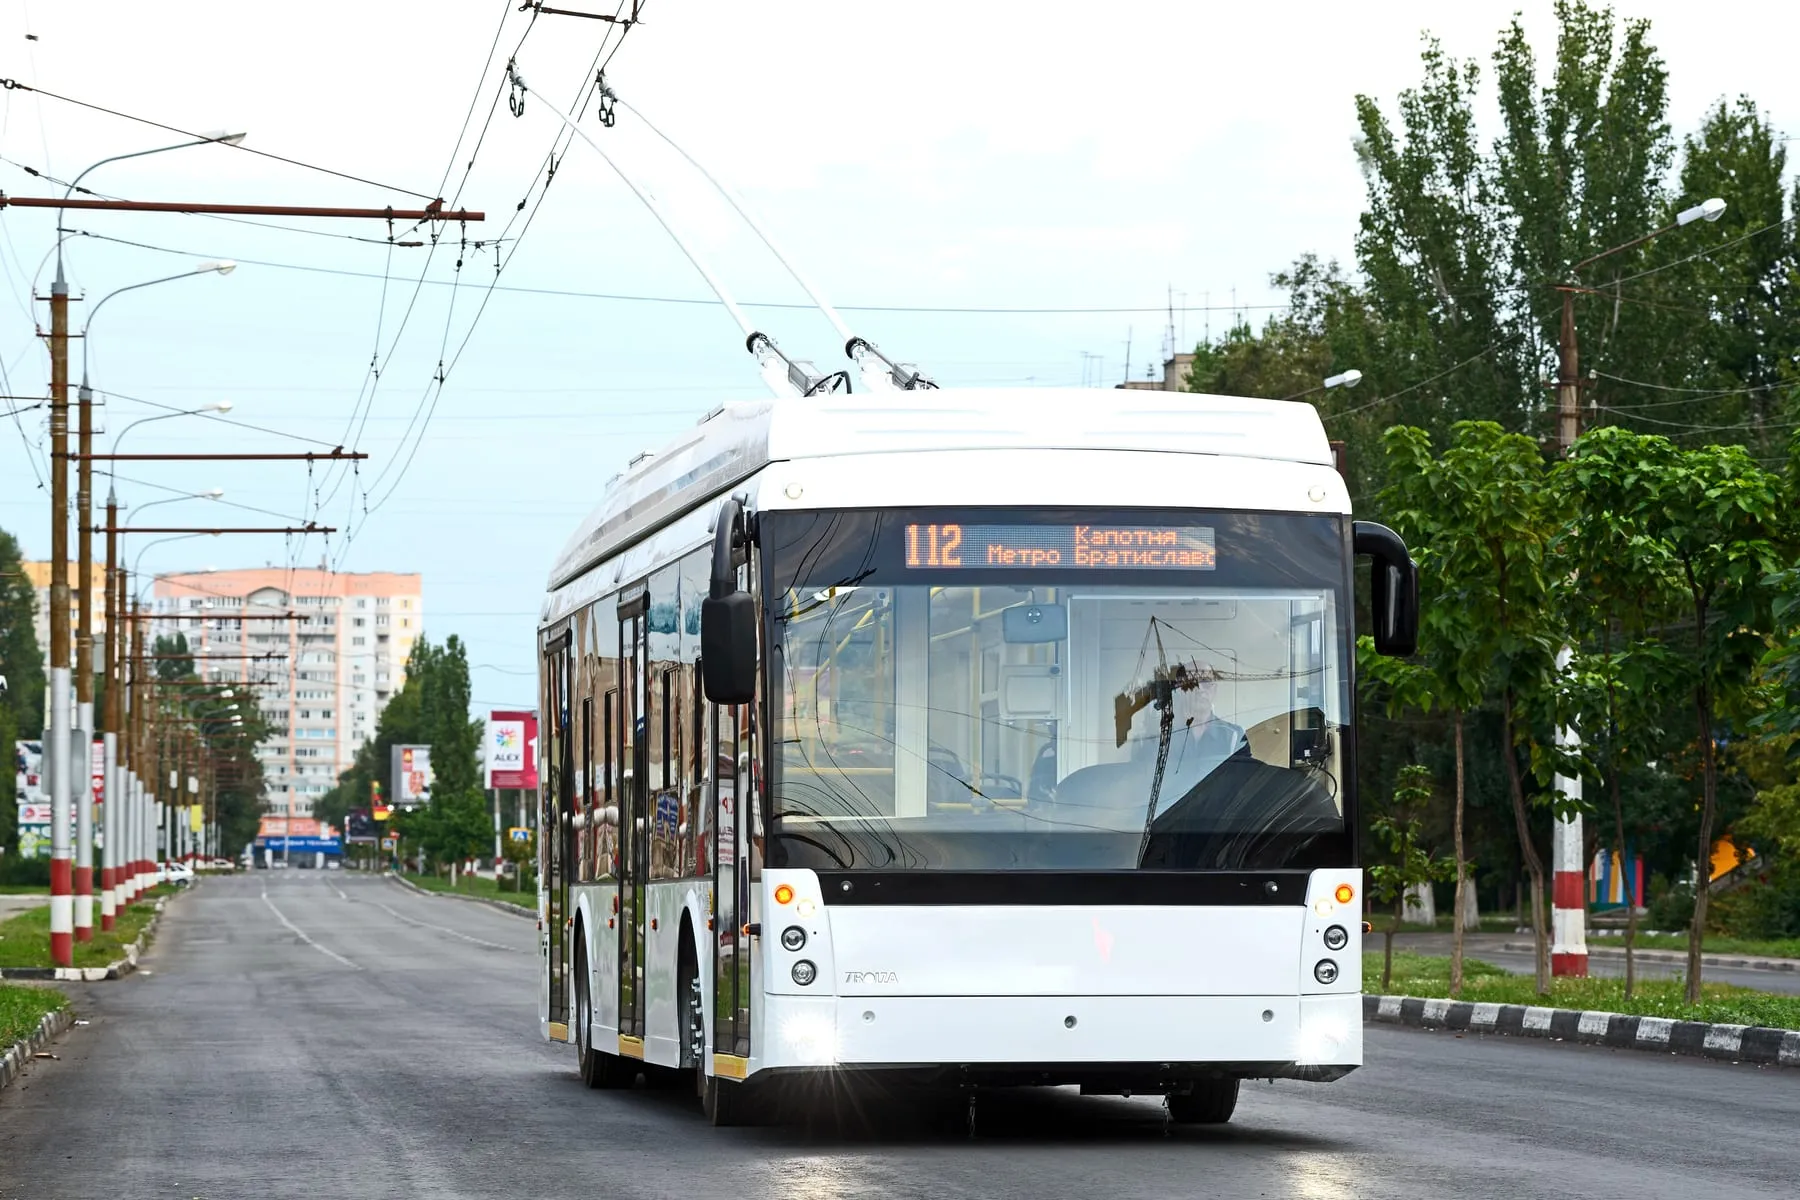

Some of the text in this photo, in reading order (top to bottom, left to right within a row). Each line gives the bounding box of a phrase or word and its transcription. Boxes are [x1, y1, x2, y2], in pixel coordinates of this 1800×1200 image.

[908, 524, 961, 566] 112
[1075, 525, 1177, 545] Капотня
[988, 544, 1060, 567] Метро
[495, 754, 520, 762] ALEX
